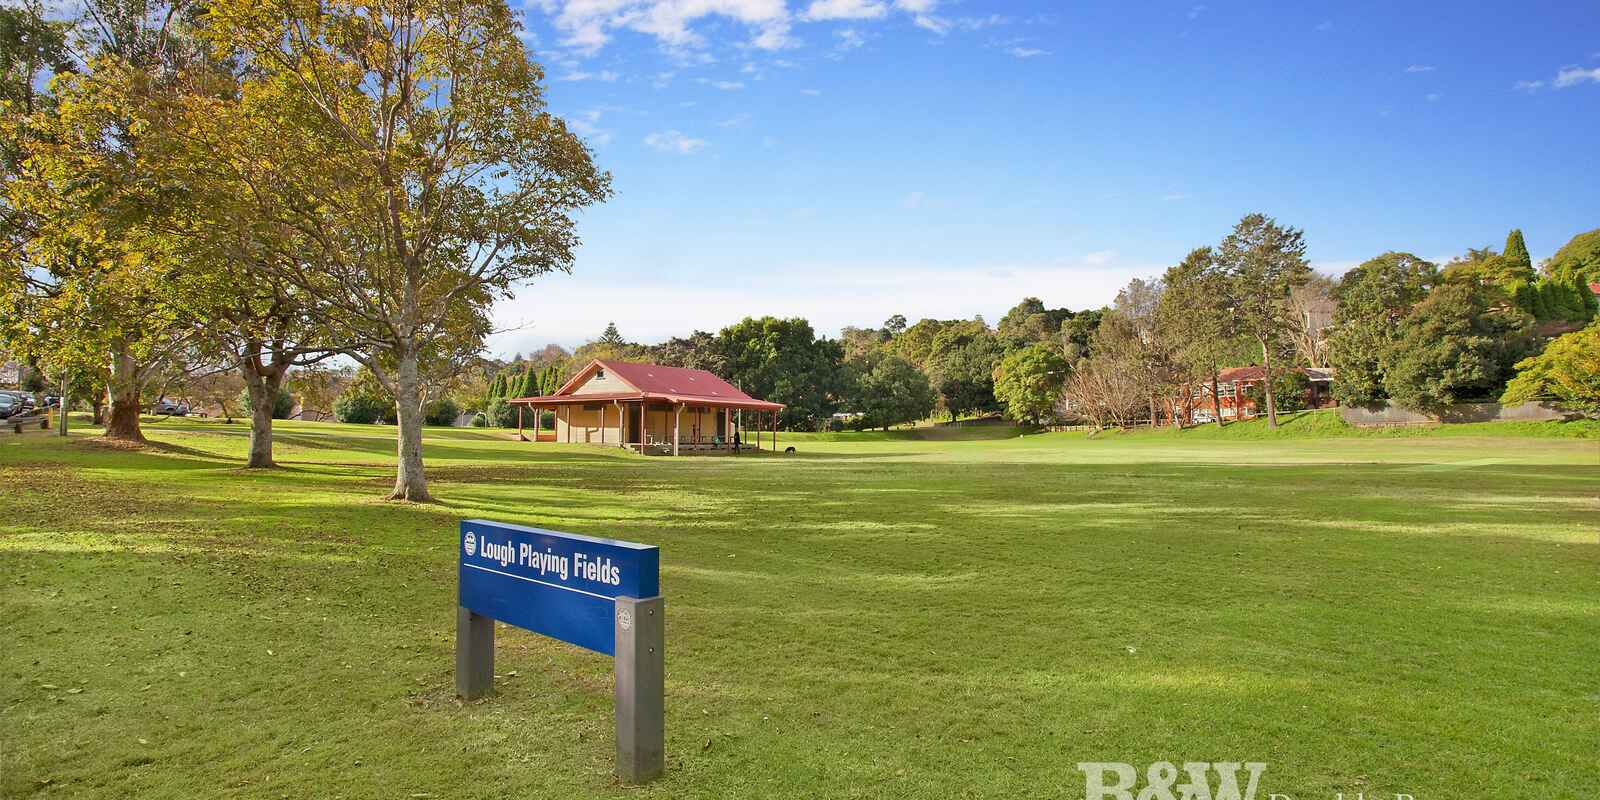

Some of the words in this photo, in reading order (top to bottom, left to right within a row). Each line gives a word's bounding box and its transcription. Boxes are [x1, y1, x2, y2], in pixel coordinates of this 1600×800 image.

[481, 535, 515, 566] Lough
[519, 542, 569, 580] Playing
[573, 552, 620, 586] Fields
